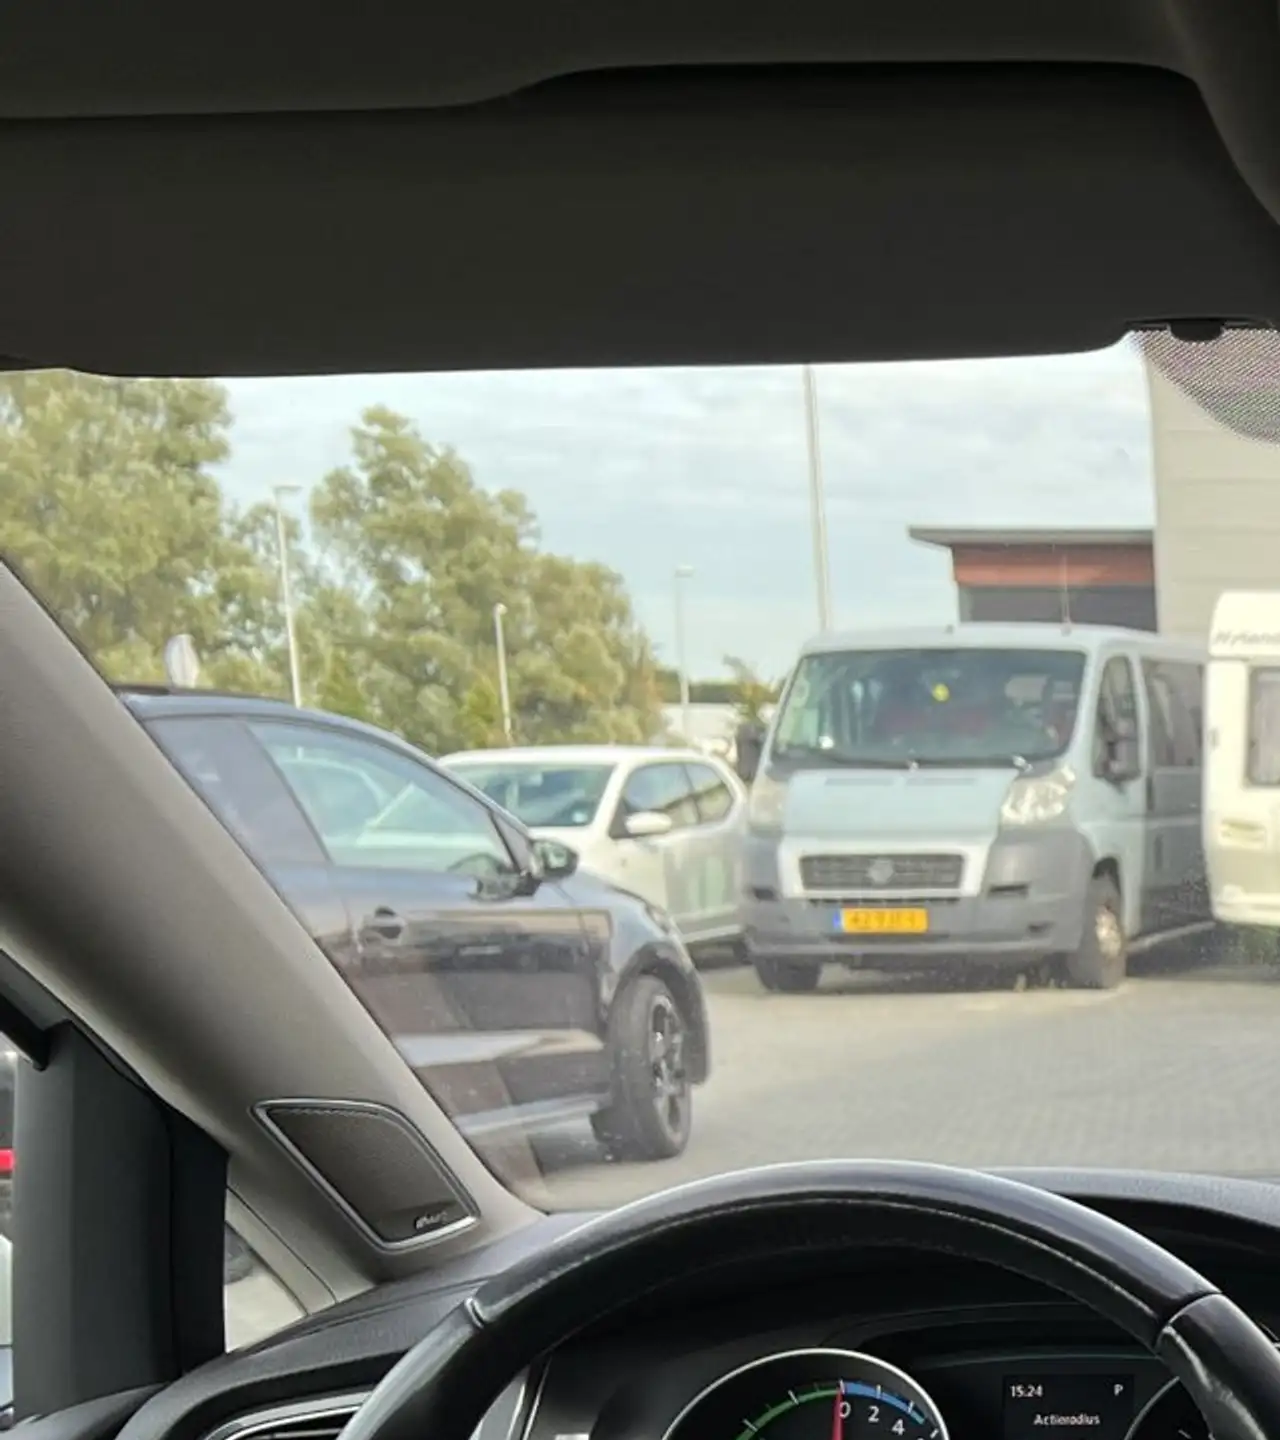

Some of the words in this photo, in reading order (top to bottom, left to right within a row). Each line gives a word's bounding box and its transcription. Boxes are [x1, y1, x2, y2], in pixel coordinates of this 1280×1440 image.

[1113, 1384, 1123, 1396] P
[868, 1406, 880, 1423] 2
[1033, 1413, 1100, 1426] Actieradius
[892, 1418, 905, 1435] 4
